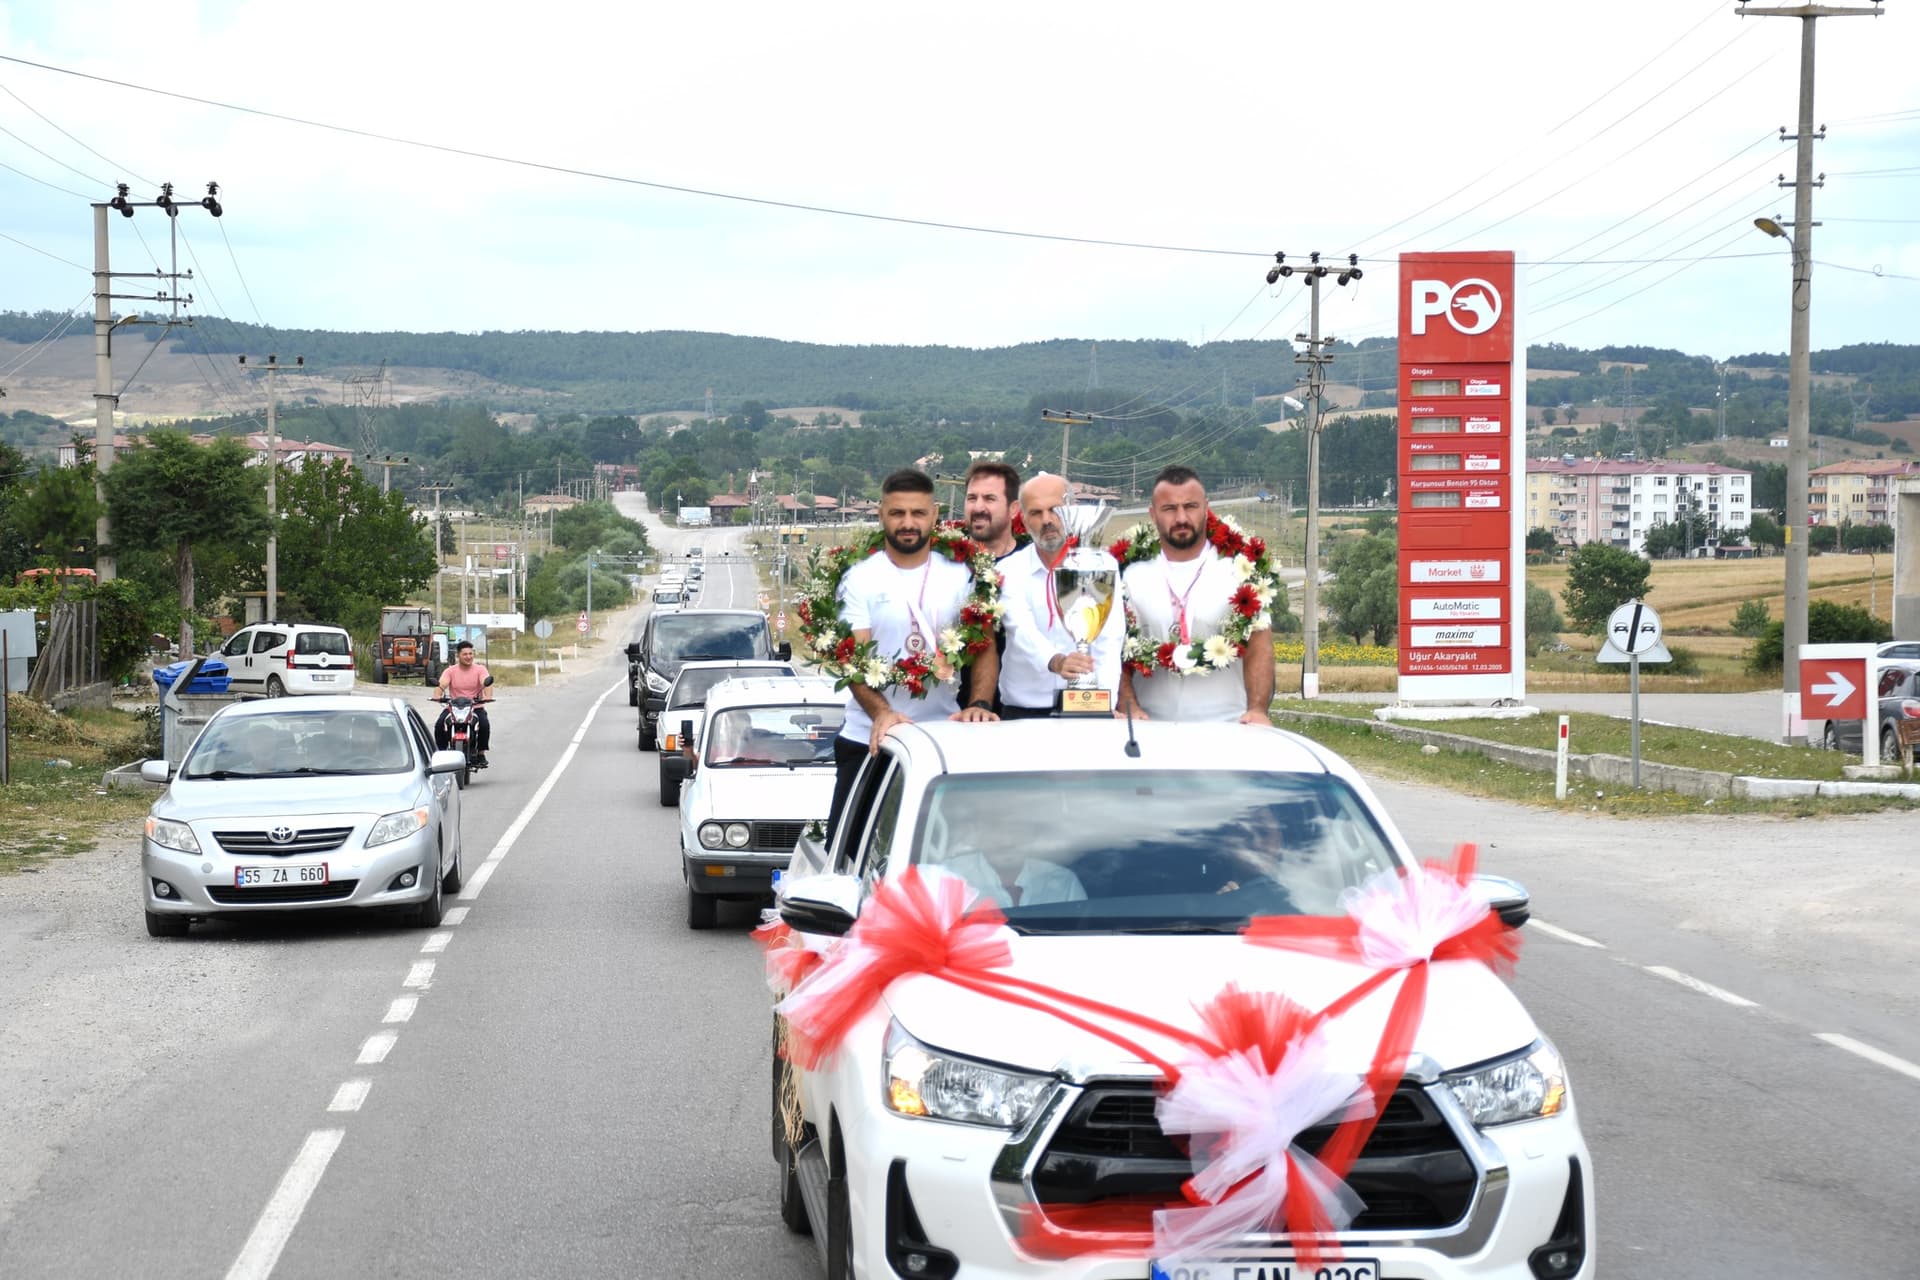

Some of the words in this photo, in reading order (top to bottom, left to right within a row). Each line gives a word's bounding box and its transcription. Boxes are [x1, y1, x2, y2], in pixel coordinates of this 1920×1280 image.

[1428, 567, 1462, 577] Market
[1433, 601, 1480, 611] AutoMatic
[1435, 629, 1475, 639] maxima
[1409, 652, 1432, 662] Uğur
[1433, 652, 1477, 662] Akaryakıt
[245, 870, 261, 884] 55
[273, 869, 288, 883] ZA
[301, 867, 324, 881] 660
